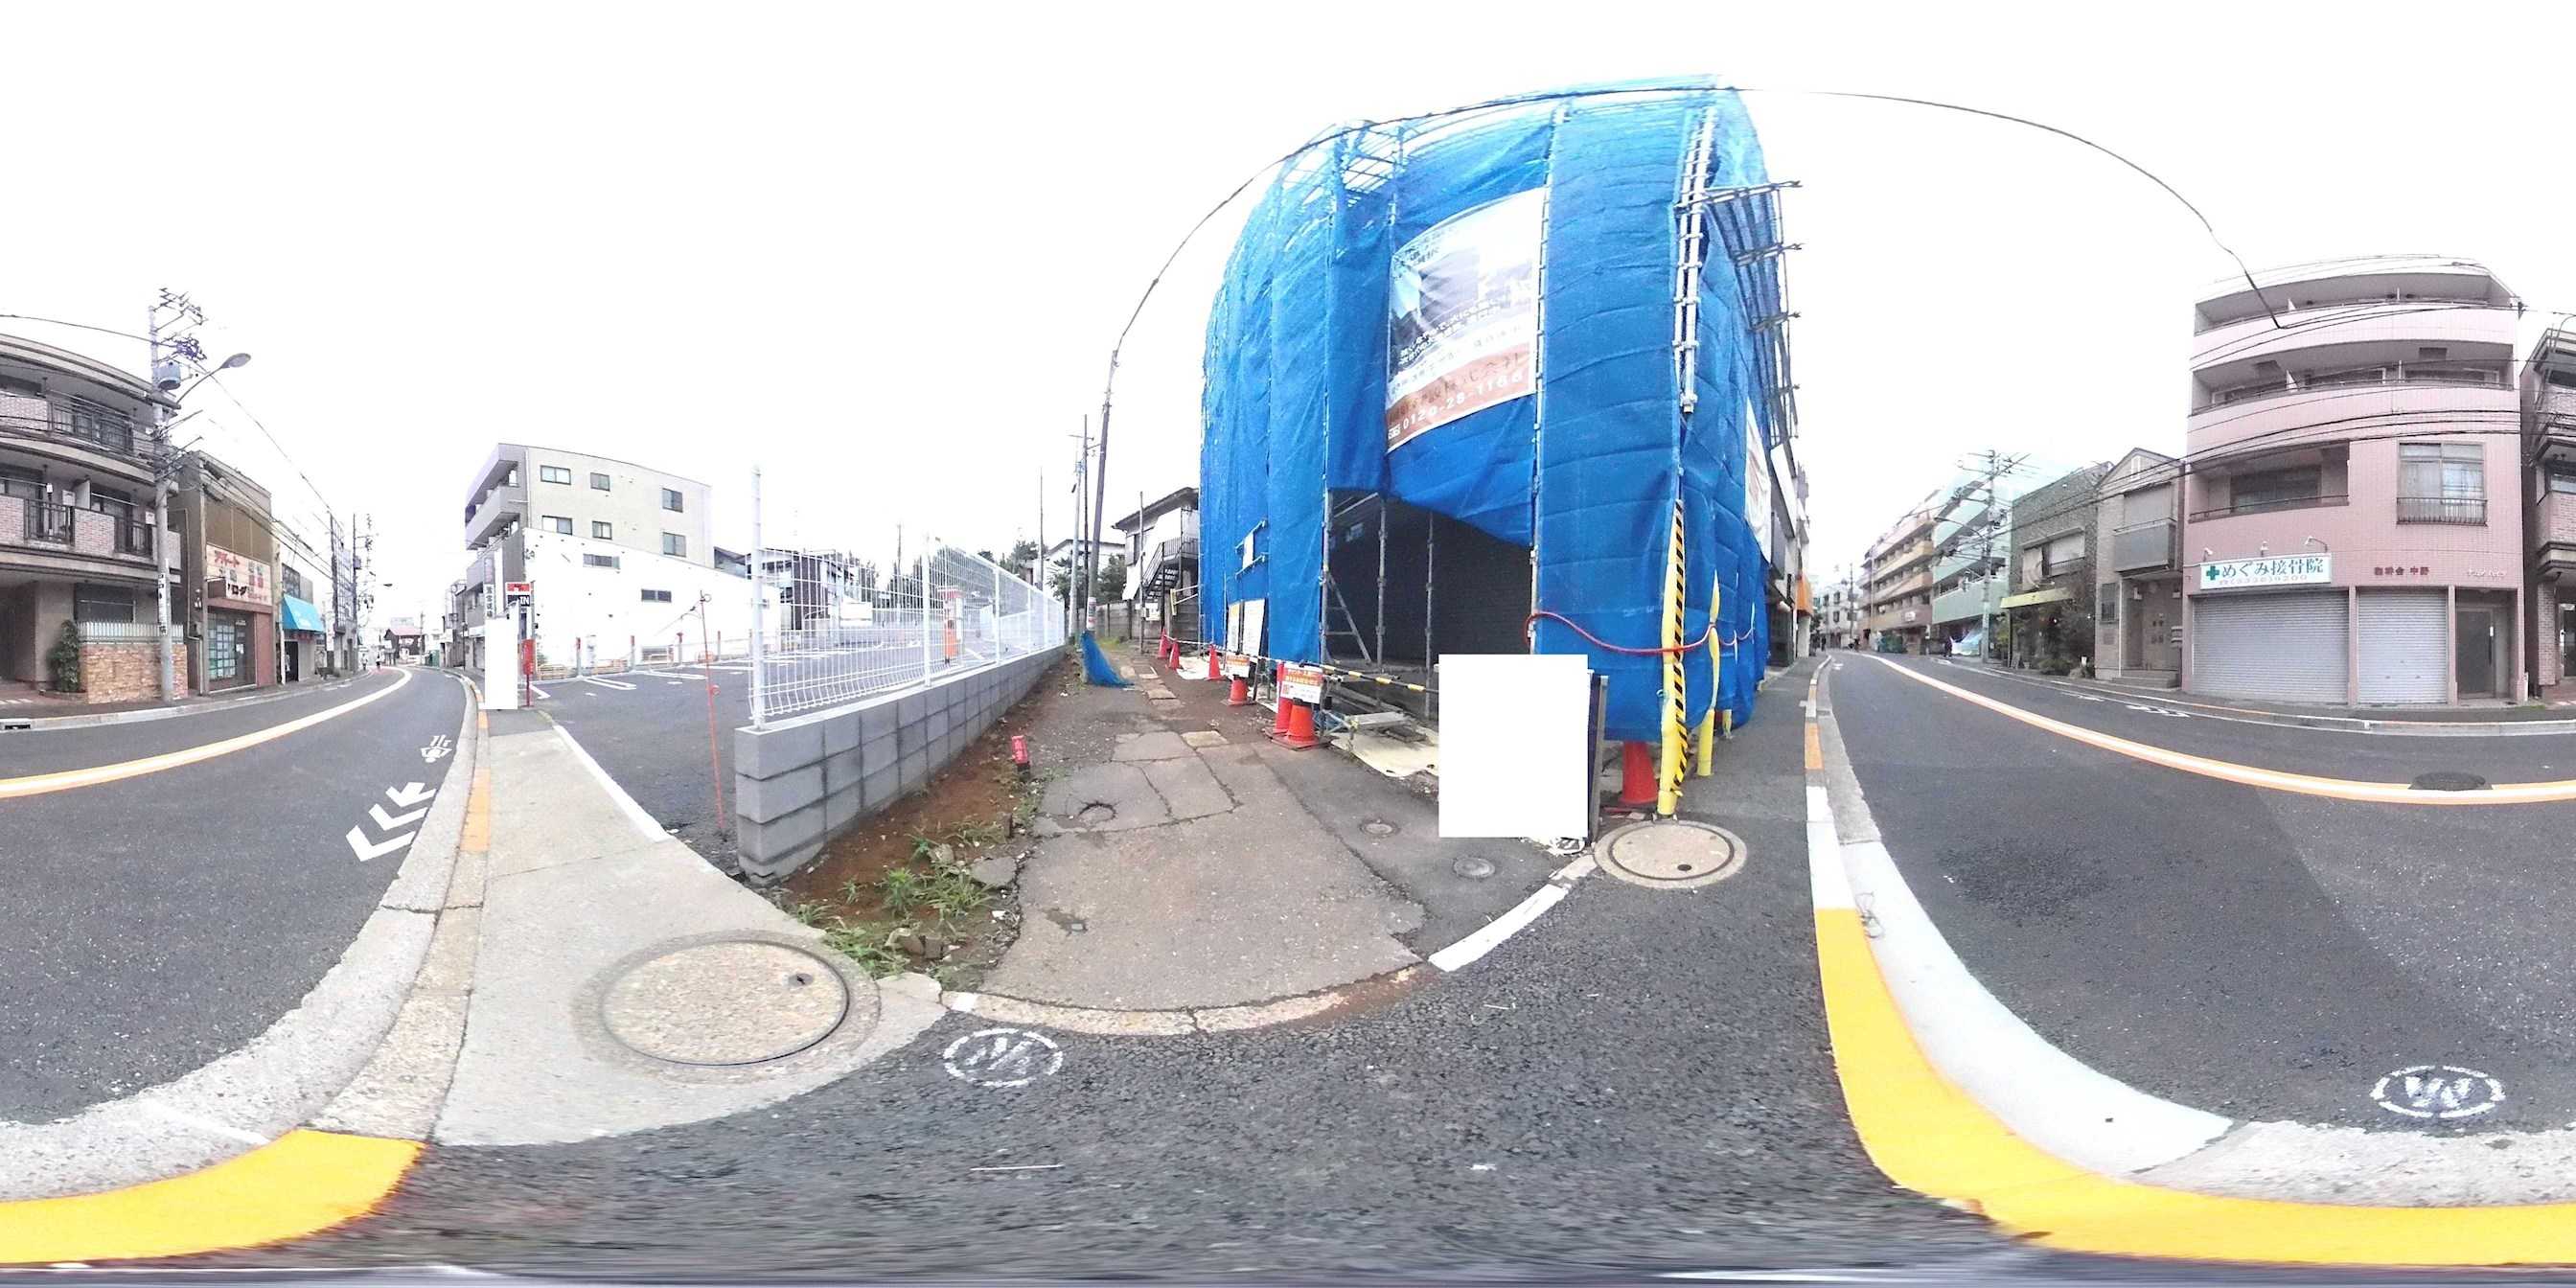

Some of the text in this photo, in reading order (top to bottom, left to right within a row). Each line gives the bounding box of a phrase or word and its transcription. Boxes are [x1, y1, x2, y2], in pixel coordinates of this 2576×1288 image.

[2221, 558, 2324, 577] めぐみ接骨院
